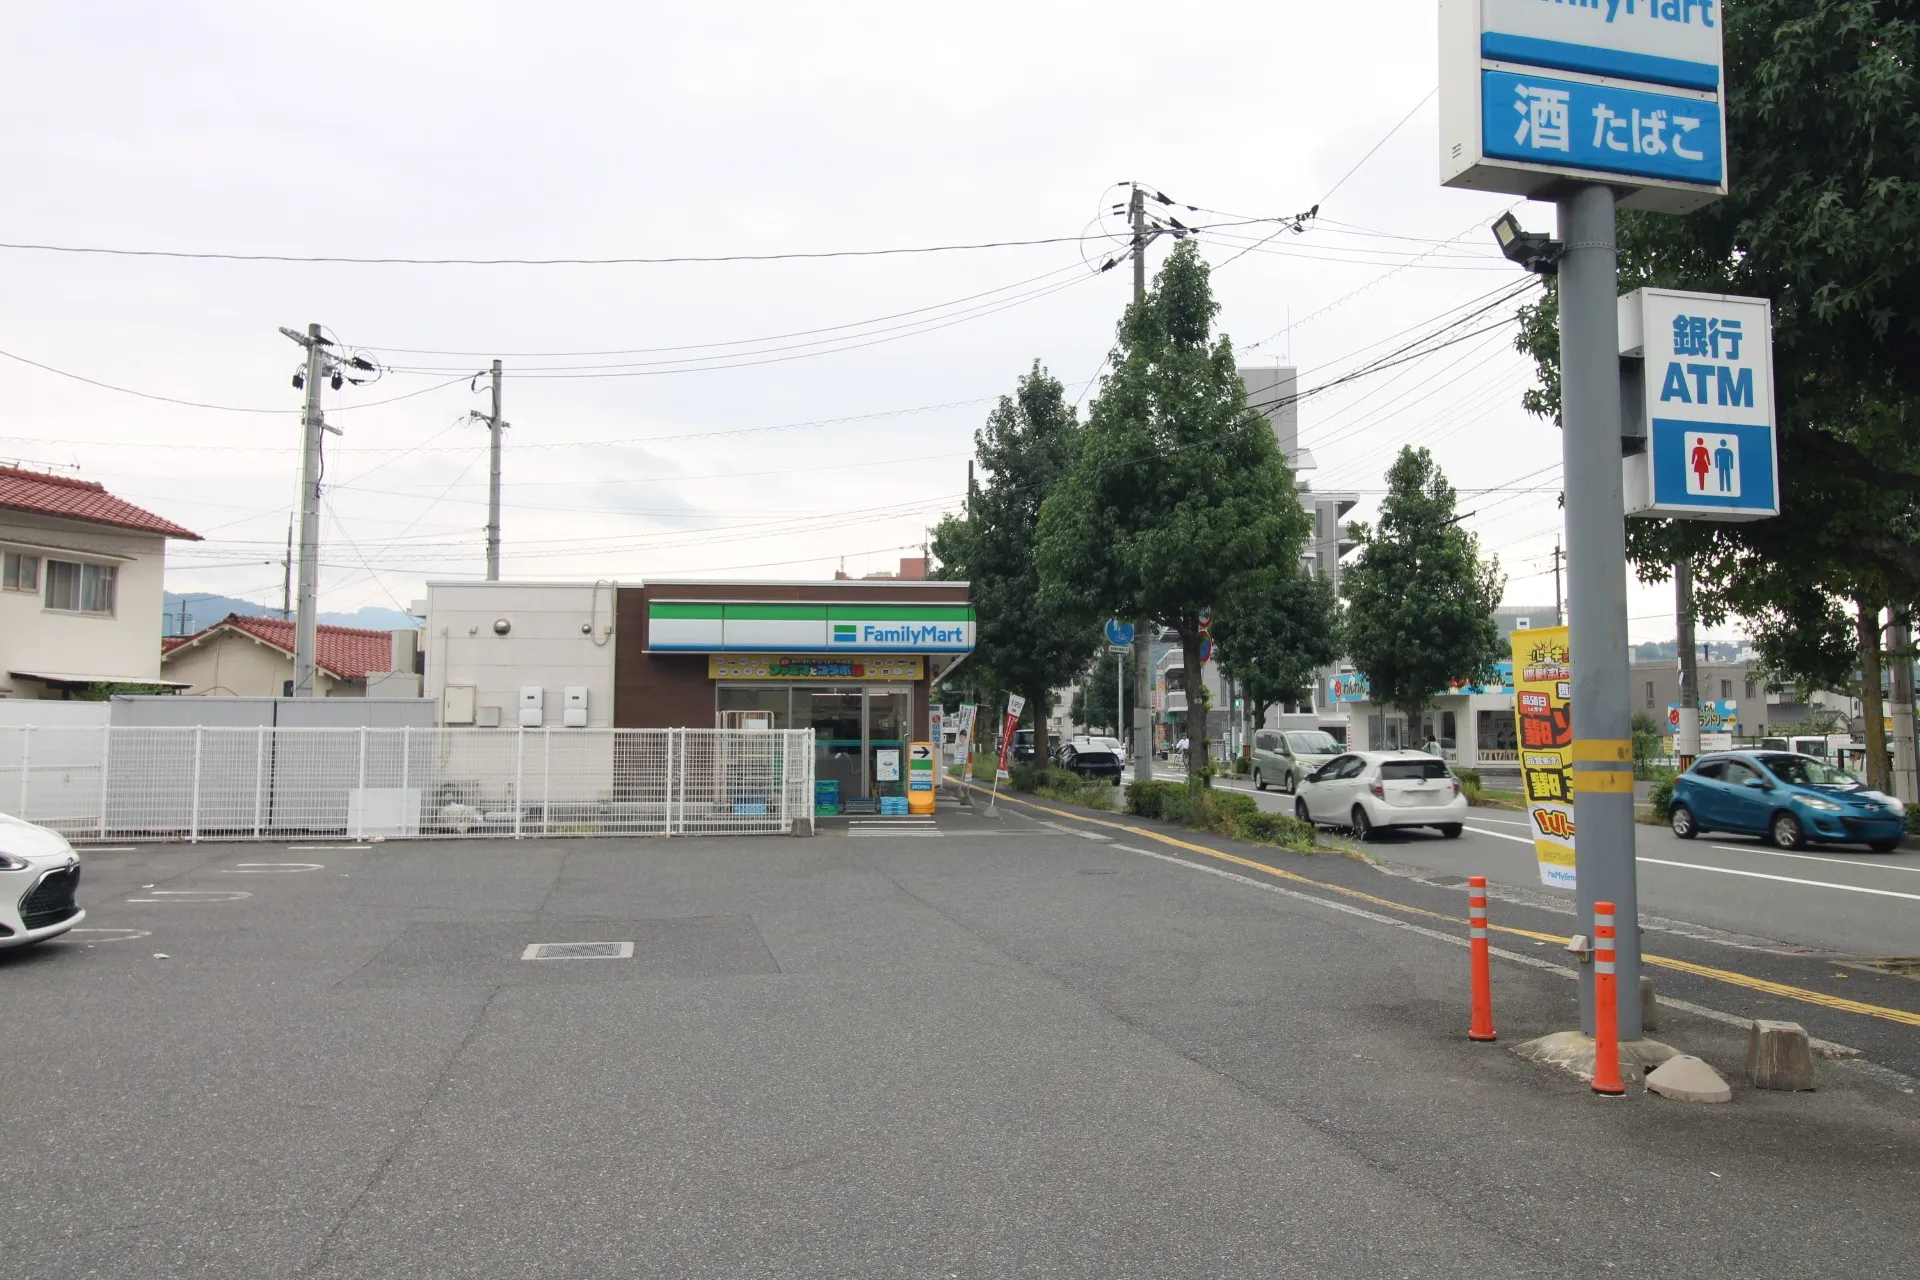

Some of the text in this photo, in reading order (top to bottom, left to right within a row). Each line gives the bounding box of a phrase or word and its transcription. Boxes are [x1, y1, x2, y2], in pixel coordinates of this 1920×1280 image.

[1513, 83, 1704, 161] 酒 たばこ
[1672, 314, 1743, 361] 銀行
[1659, 362, 1755, 408] ATM
[864, 625, 963, 645] FamilyMart
